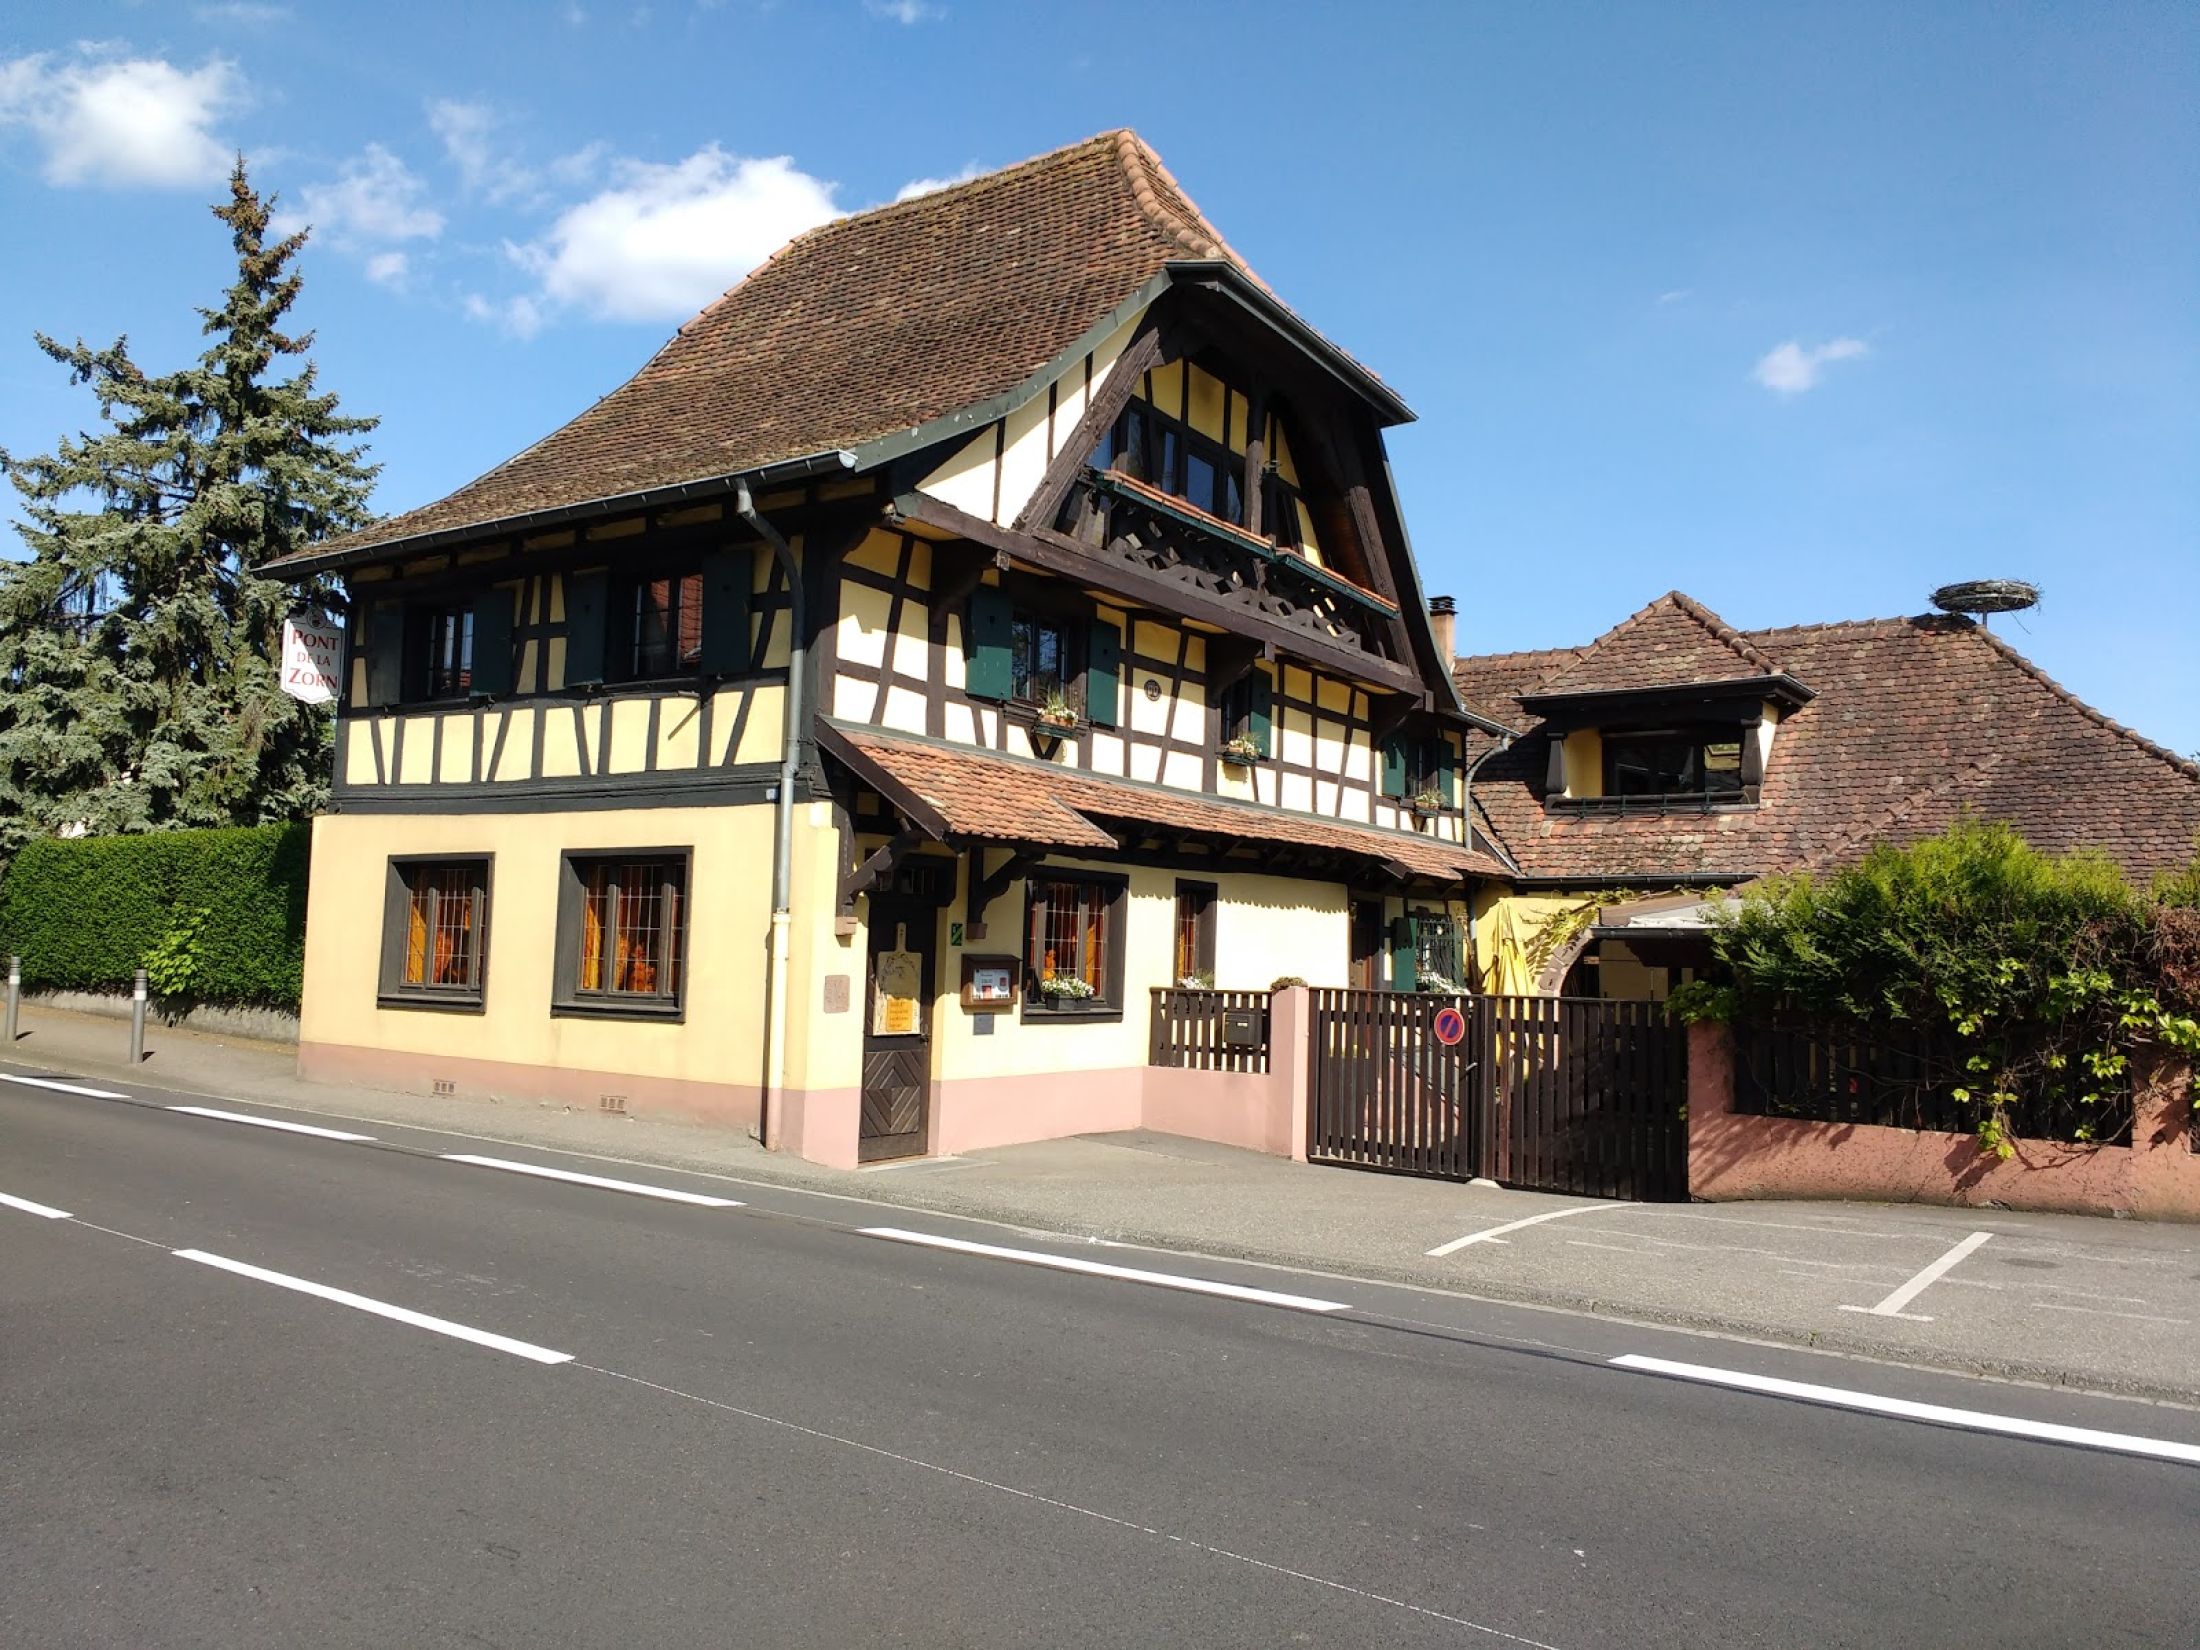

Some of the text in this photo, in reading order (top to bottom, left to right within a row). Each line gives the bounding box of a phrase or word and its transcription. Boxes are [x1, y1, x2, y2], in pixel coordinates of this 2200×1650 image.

[292, 629, 338, 650] PONT
[317, 655, 331, 666] LA
[288, 667, 338, 689] ZORN
